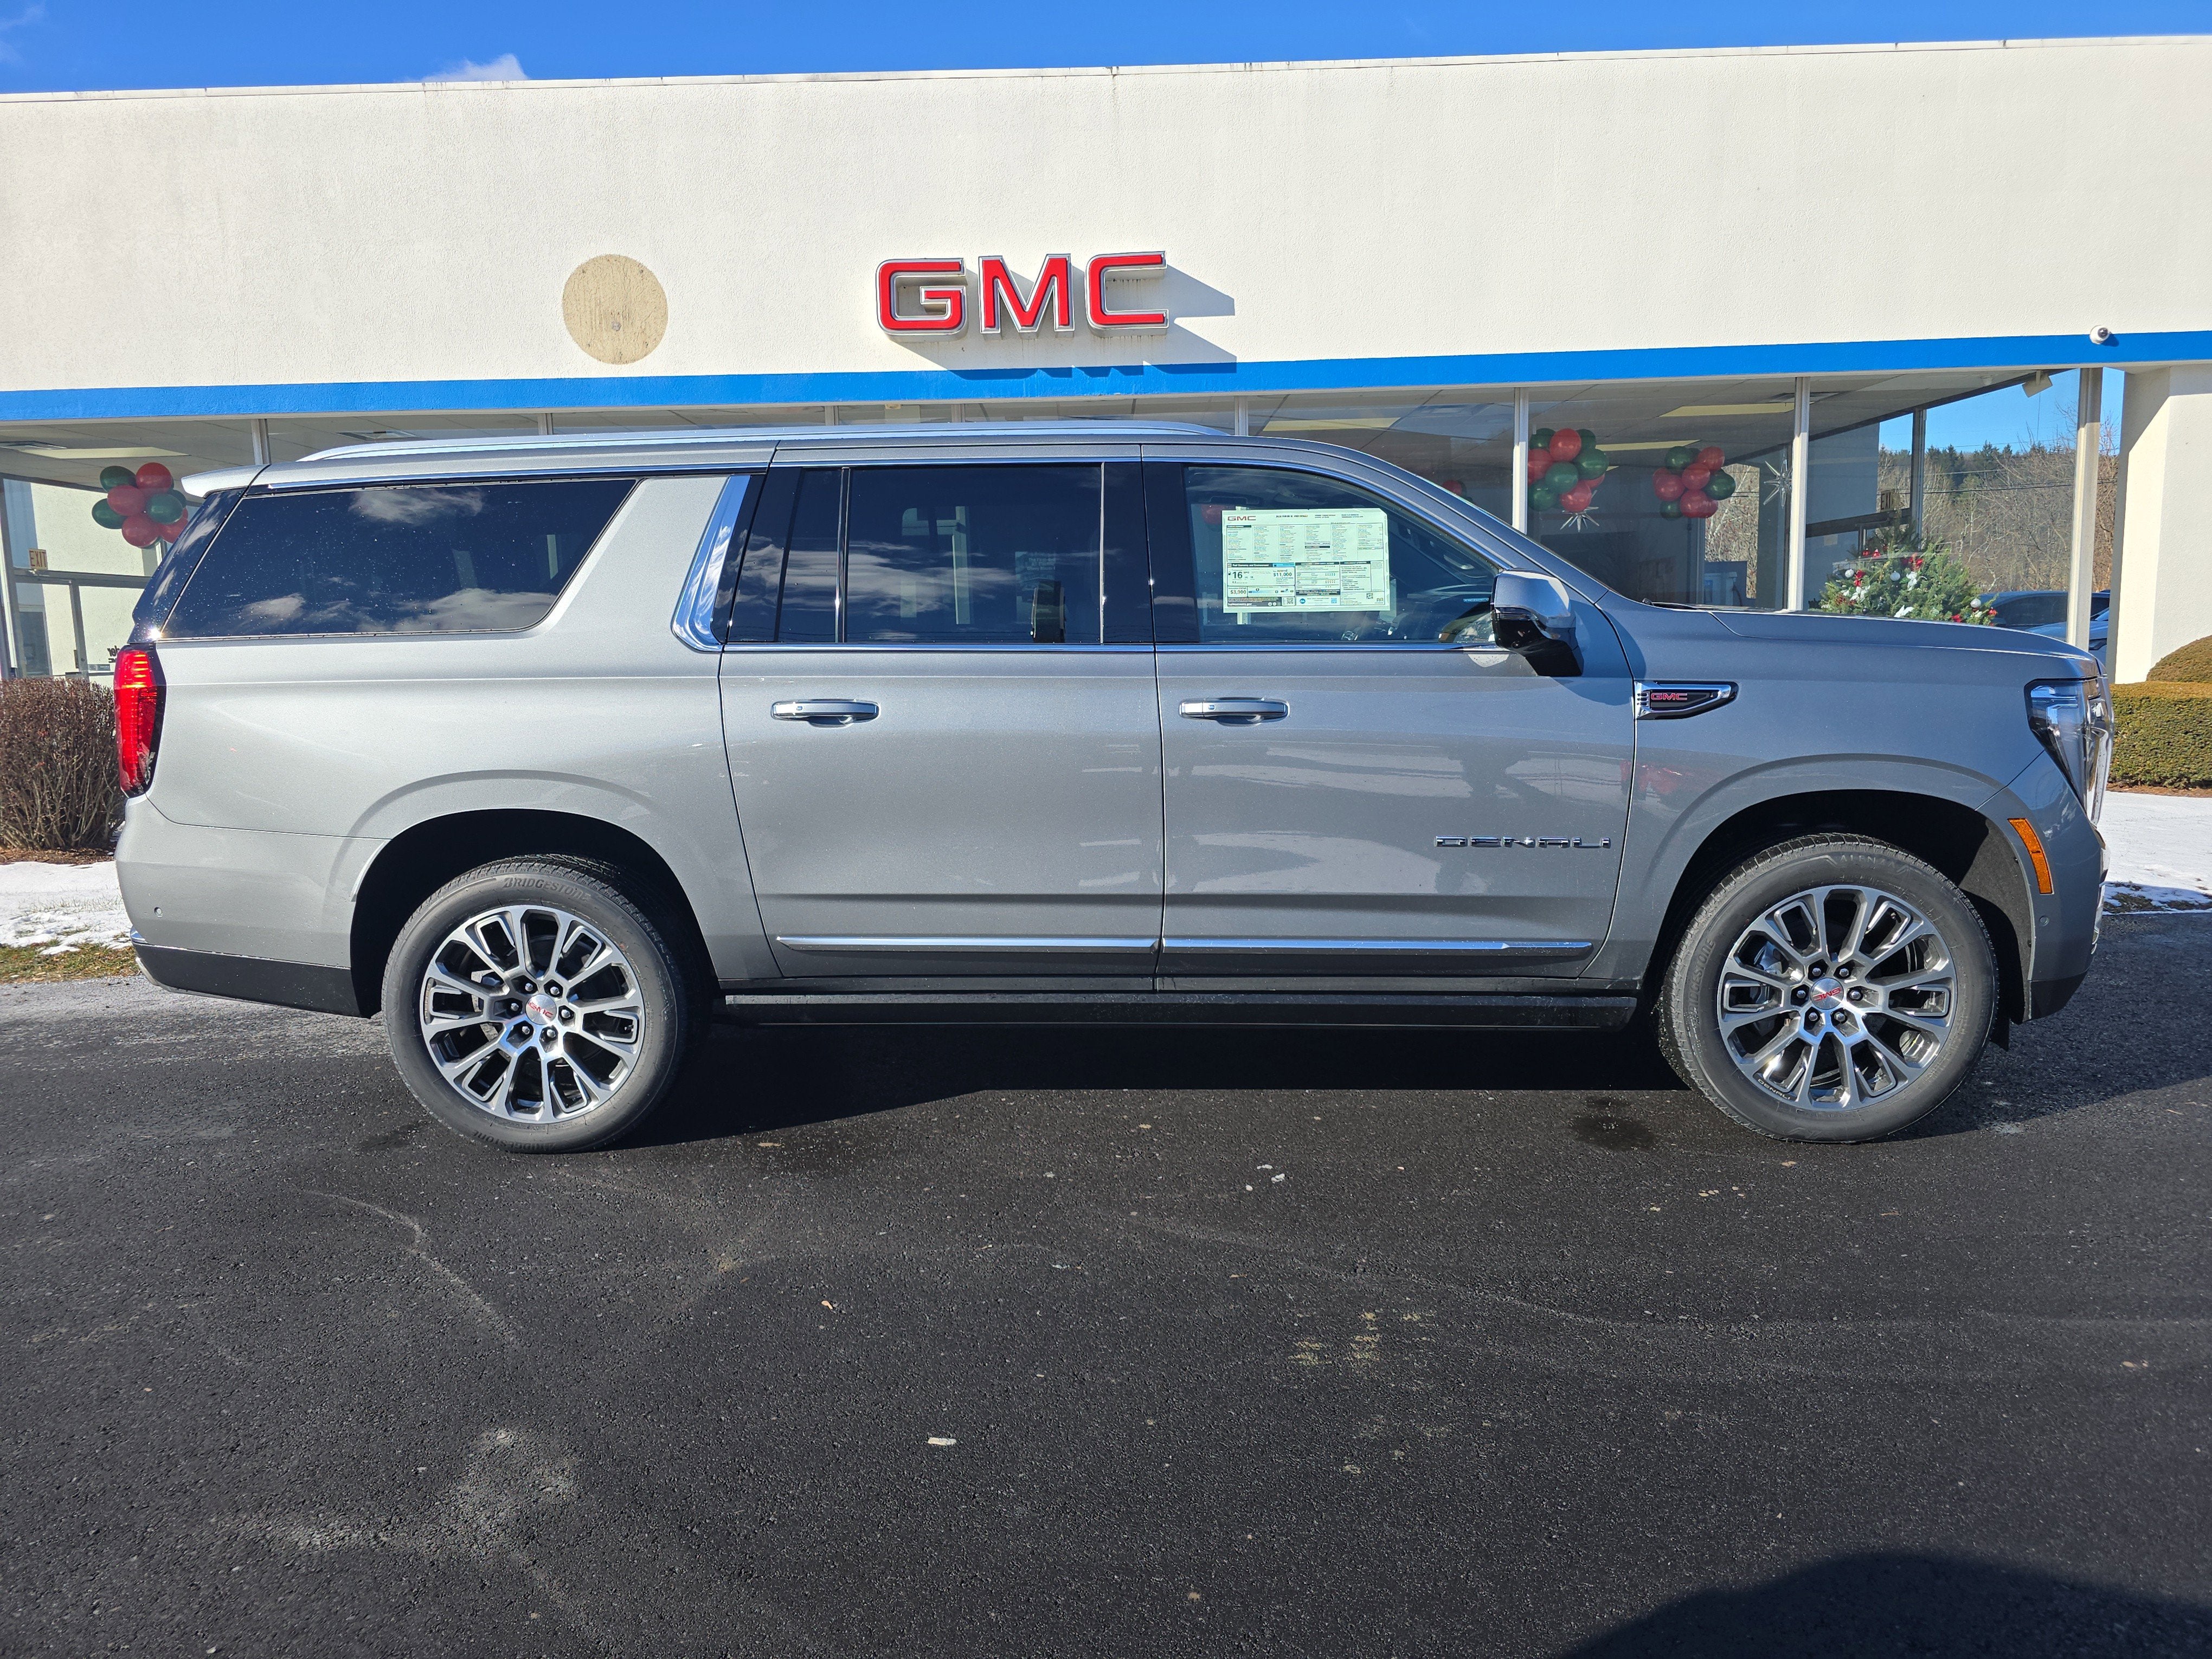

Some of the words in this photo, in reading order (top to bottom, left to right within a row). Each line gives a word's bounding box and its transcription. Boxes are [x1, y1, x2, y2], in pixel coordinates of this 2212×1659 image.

[876, 250, 1169, 336] GMC
[29, 550, 47, 567] EXIT
[1651, 692, 1688, 700] GMC
[1435, 835, 1611, 848] DENALI
[503, 877, 591, 902] BRIDGESTONE
[1688, 939, 1715, 1024] RIDGESTONE
[1812, 987, 1842, 1001] GMC
[529, 1002, 554, 1019] GMC
[1758, 1078, 1791, 1100] DENALI
